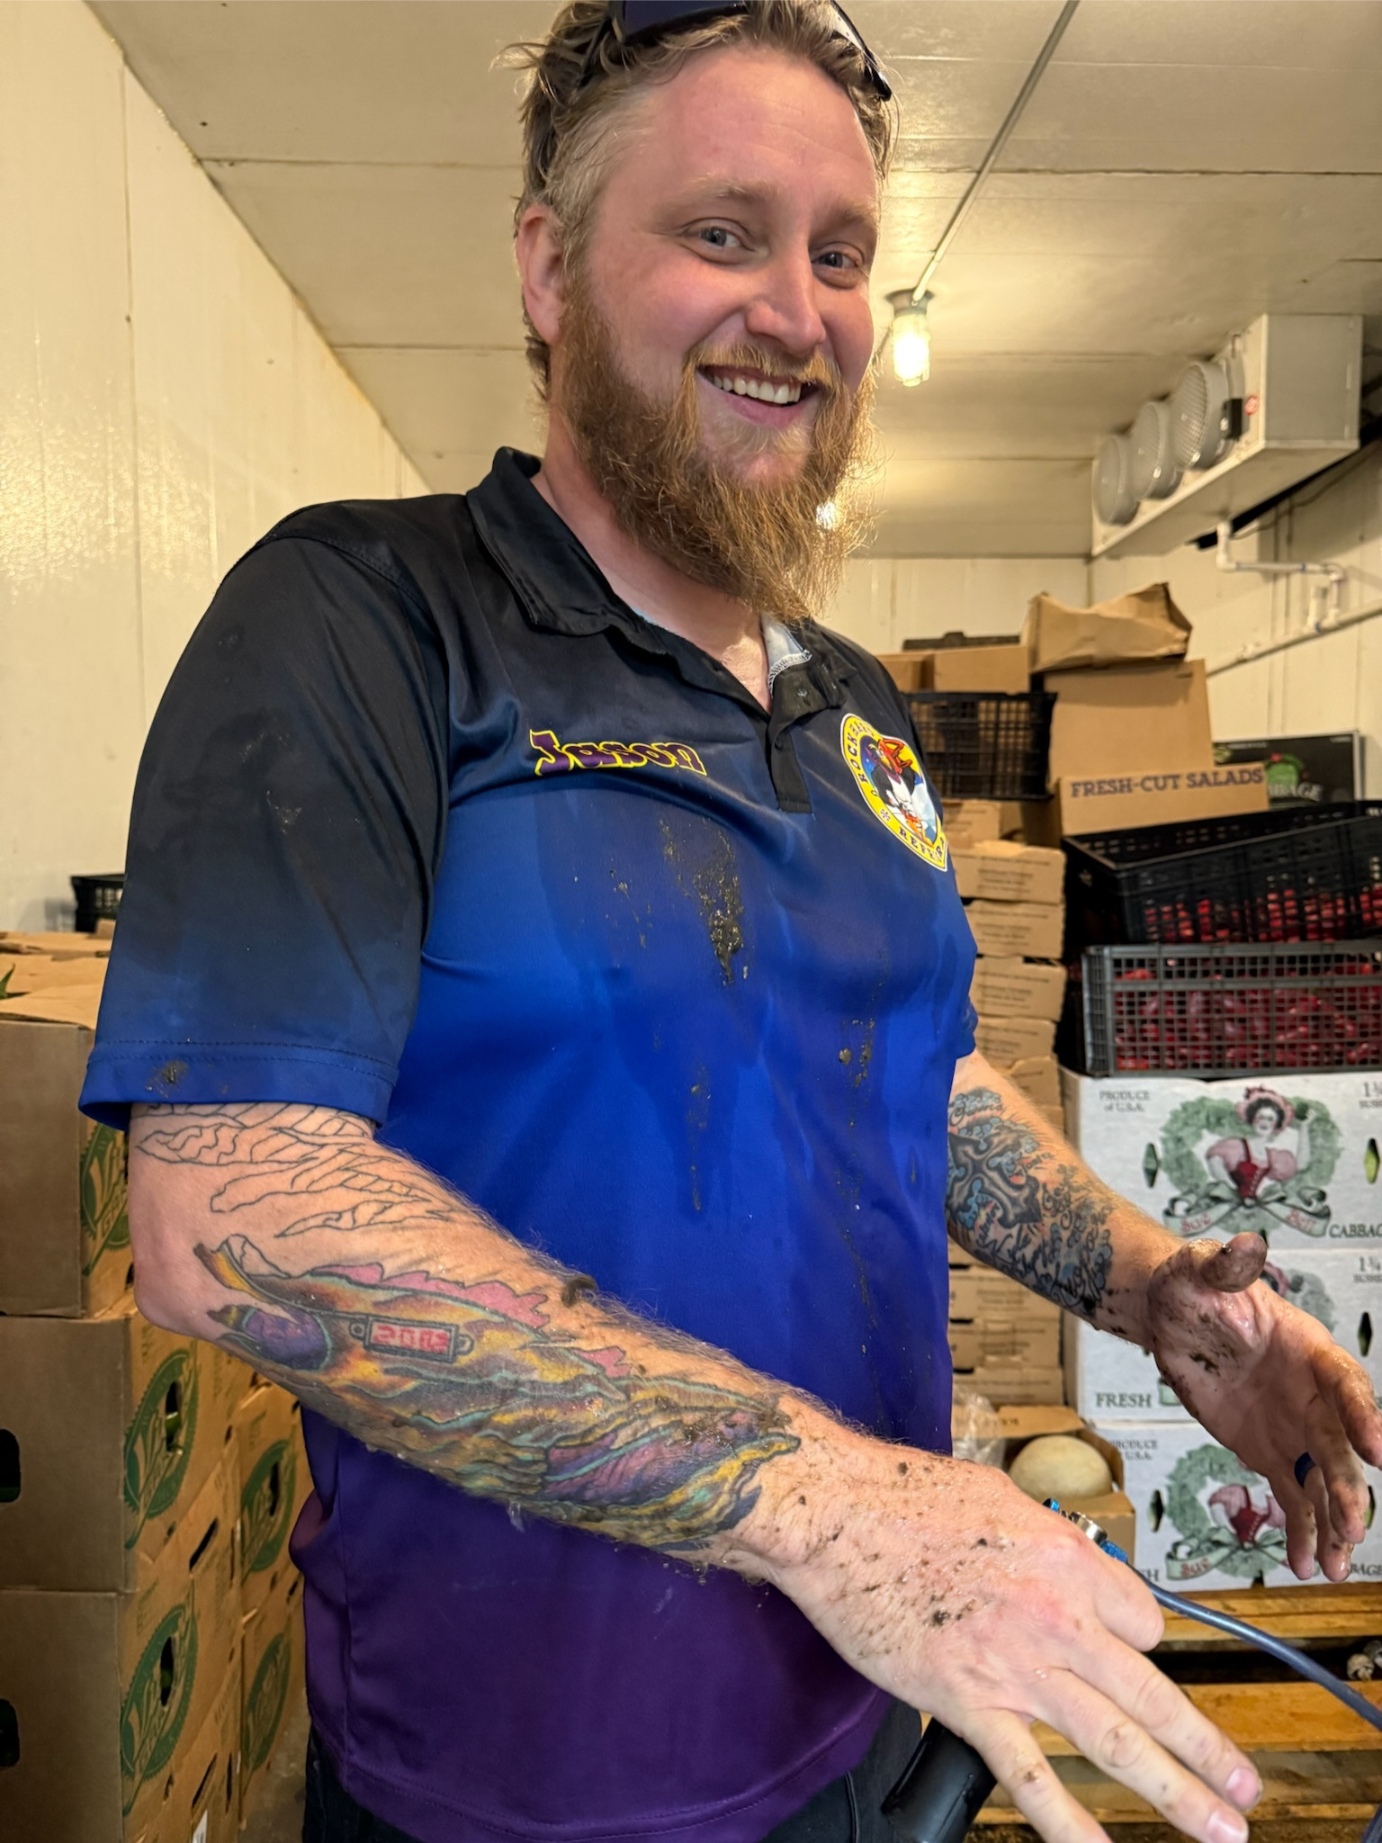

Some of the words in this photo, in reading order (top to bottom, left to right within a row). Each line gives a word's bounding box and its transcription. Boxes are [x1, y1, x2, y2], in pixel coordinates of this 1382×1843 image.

[529, 729, 707, 776] Jason
[1071, 774, 1181, 798] FRESH-CUT
[1186, 768, 1263, 788] SALADS
[1099, 1089, 1150, 1101] PRODUCE
[1096, 1392, 1152, 1409] FRESH
